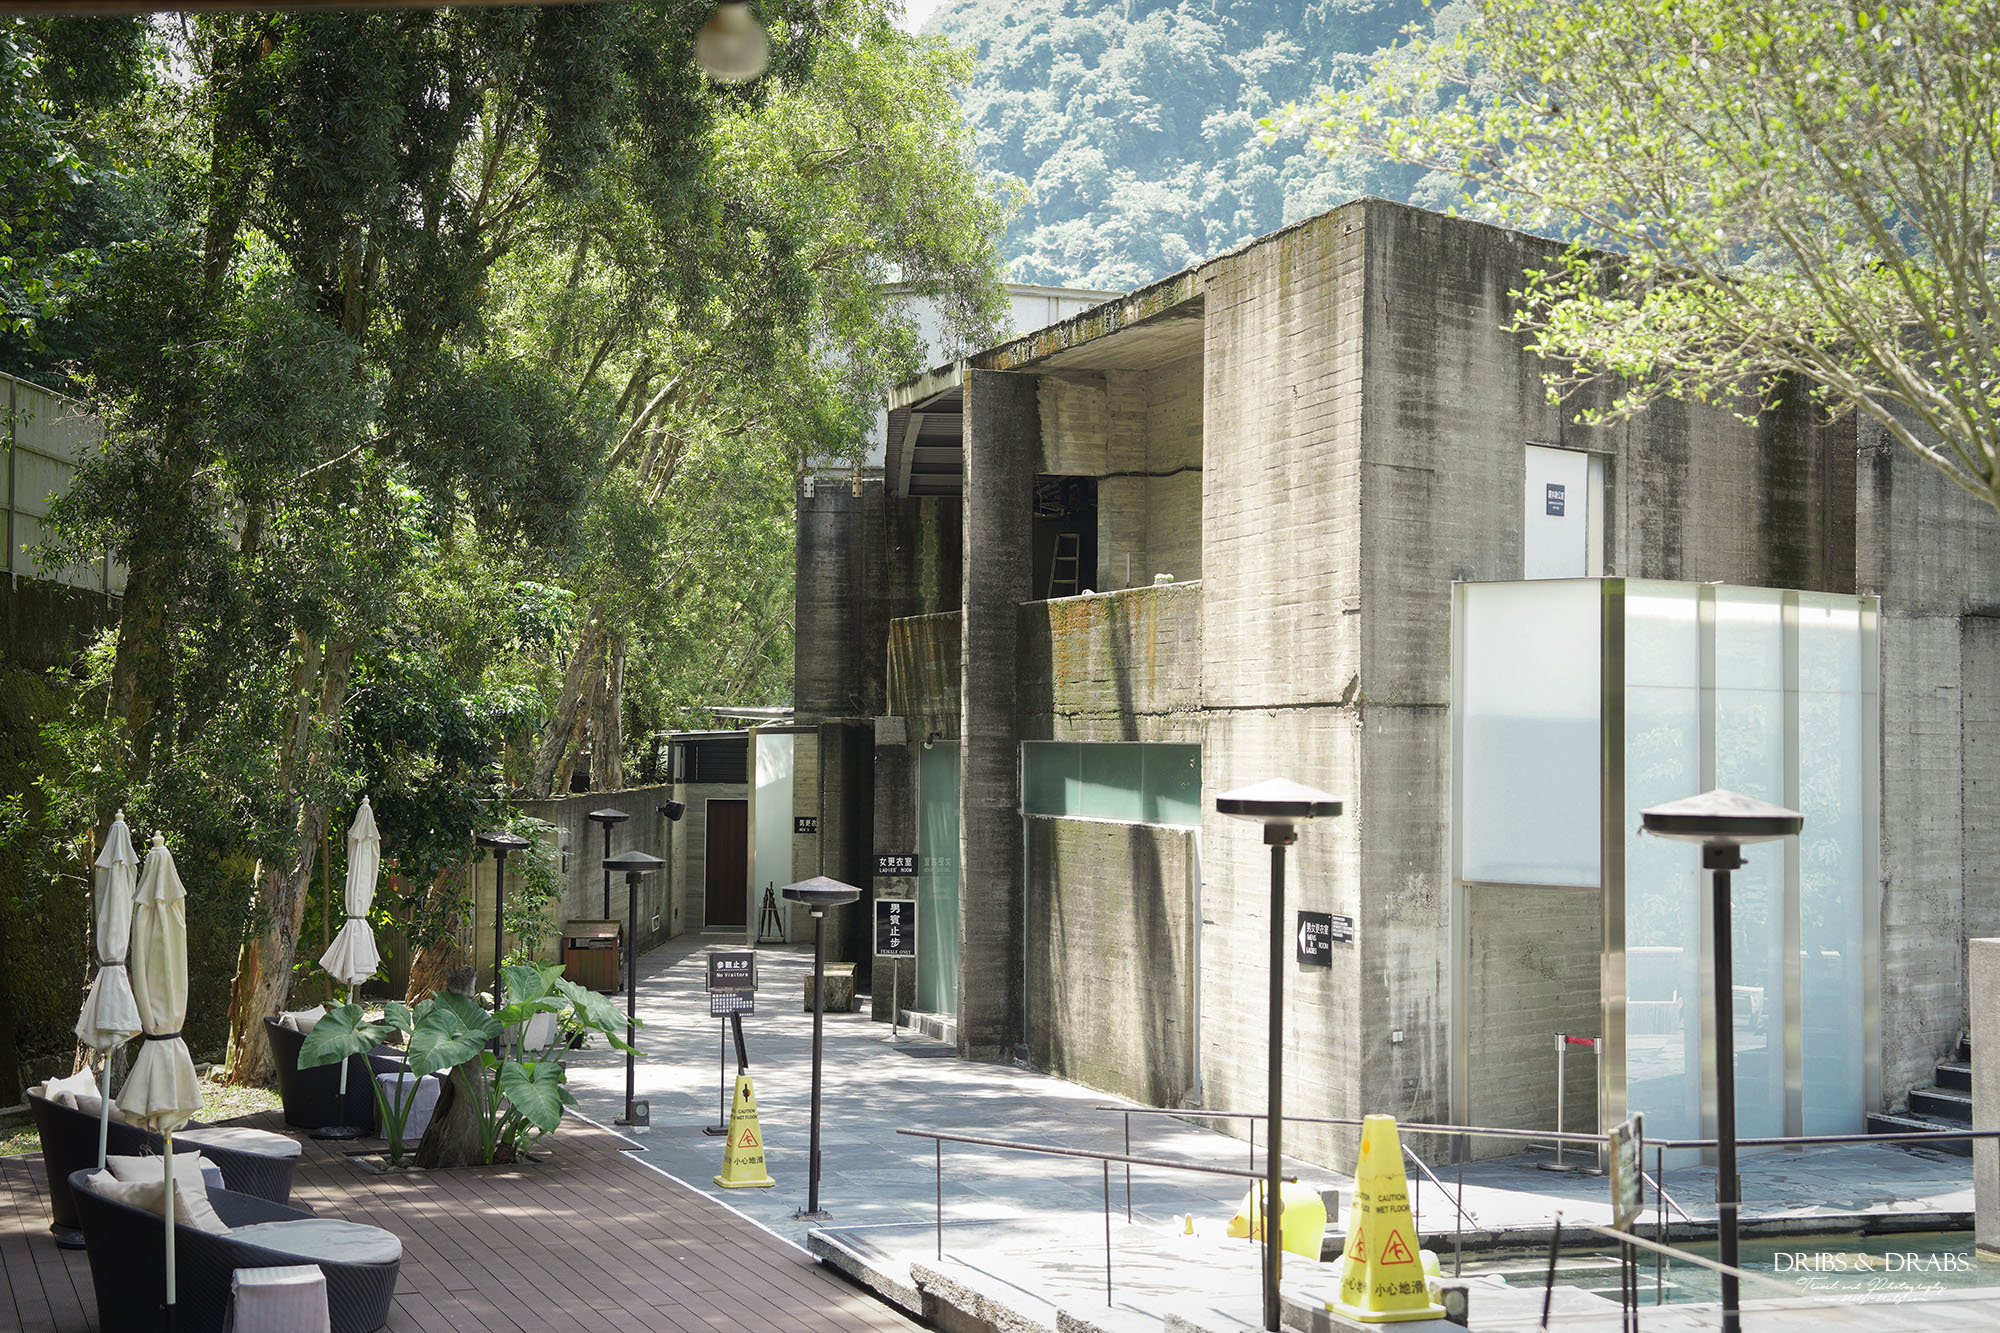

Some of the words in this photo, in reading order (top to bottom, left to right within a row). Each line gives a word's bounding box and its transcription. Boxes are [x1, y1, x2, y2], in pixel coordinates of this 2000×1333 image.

[879, 857, 913, 867] 女更衣室
[889, 903, 901, 948] 男賓止步
[1306, 922, 1329, 935] 男女更衣室
[716, 960, 749, 969] 參觀止步
[733, 1155, 764, 1166] 小心地滑
[1378, 1193, 1406, 1202] CAUTION
[1376, 1205, 1389, 1213] WET
[1390, 1204, 1410, 1212] FLOOR
[1375, 1280, 1424, 1297] 小心地滑
